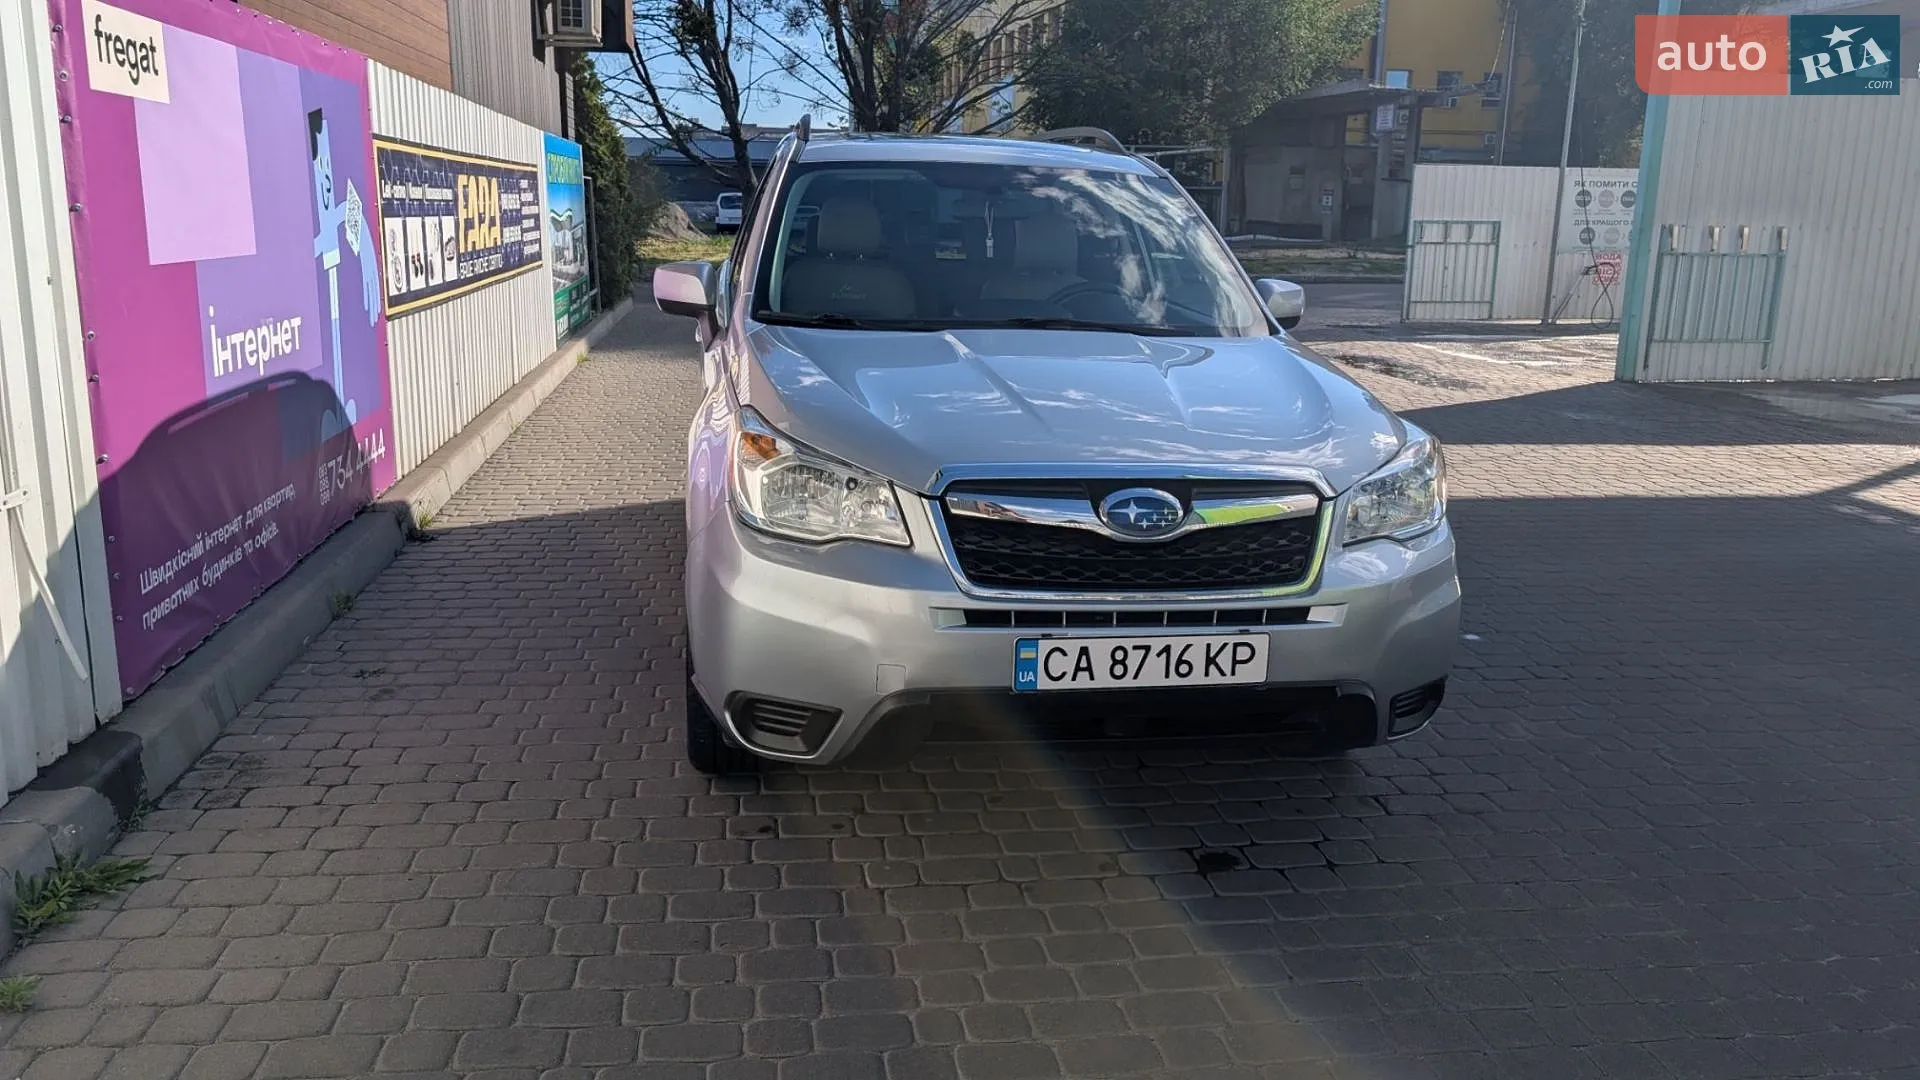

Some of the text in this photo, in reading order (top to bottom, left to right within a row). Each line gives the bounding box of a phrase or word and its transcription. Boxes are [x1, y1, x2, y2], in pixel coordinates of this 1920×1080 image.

[94, 14, 159, 86] fregat
[457, 174, 502, 254] FARA
[209, 304, 302, 378] інтернет
[327, 449, 354, 497] 734
[140, 532, 205, 596] Швидкісний
[204, 515, 243, 551] інтернет
[245, 503, 264, 530] для
[142, 576, 200, 630] приватних
[201, 545, 243, 588] будинків
[243, 539, 254, 556] та
[1019, 671, 1036, 682] UA
[1043, 641, 1256, 682] CA 8716 KP
